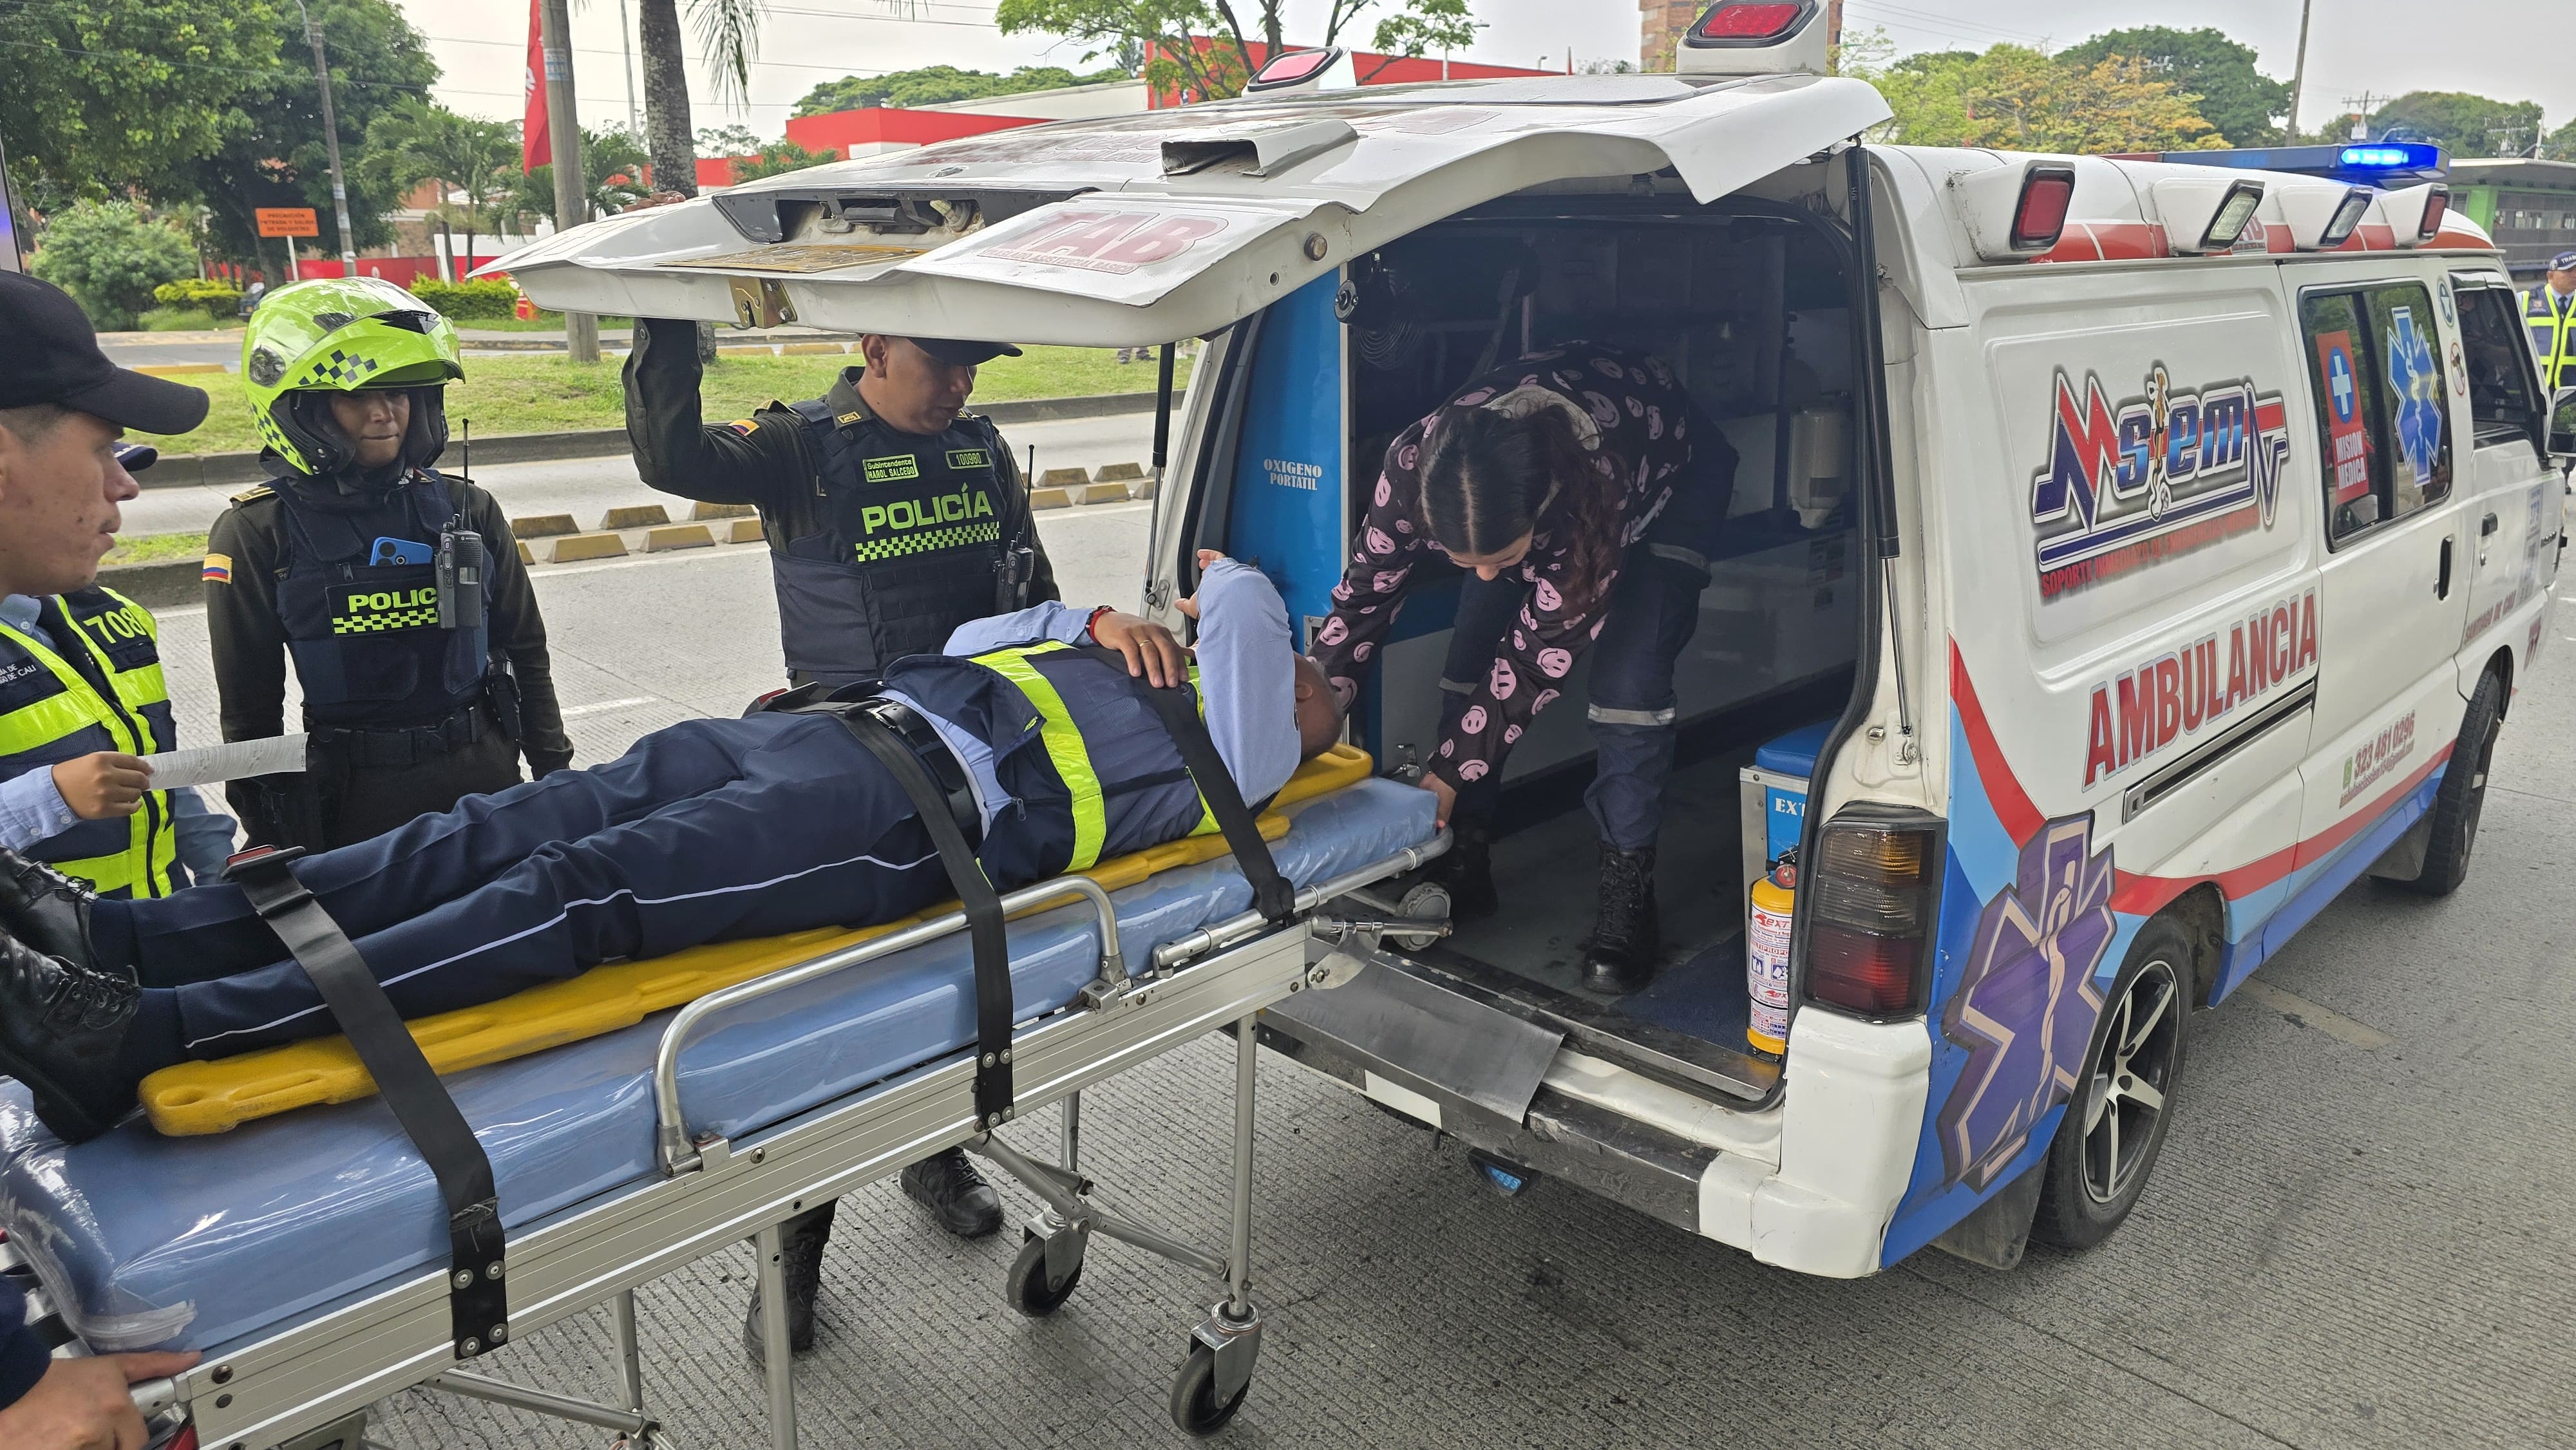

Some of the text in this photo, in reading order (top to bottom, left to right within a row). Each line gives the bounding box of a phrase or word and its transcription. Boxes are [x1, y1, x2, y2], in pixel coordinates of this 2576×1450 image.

[2335, 430, 2363, 463] MISION
[867, 459, 912, 470] Subintendente
[889, 466, 915, 477] SALCEDO
[1263, 458, 1323, 478] OXIGENO
[2338, 457, 2366, 490] MEDICA
[1269, 472, 1318, 491] PORTATIL
[861, 482, 994, 535] POLICÍA
[2041, 560, 2092, 598] SOPORTE
[348, 587, 438, 613] POLIC
[82, 607, 147, 644] 708
[17, 664, 37, 676] CALI
[2081, 587, 2319, 793] AMBULANCIA
[2354, 709, 2416, 780] 323 481 0296
